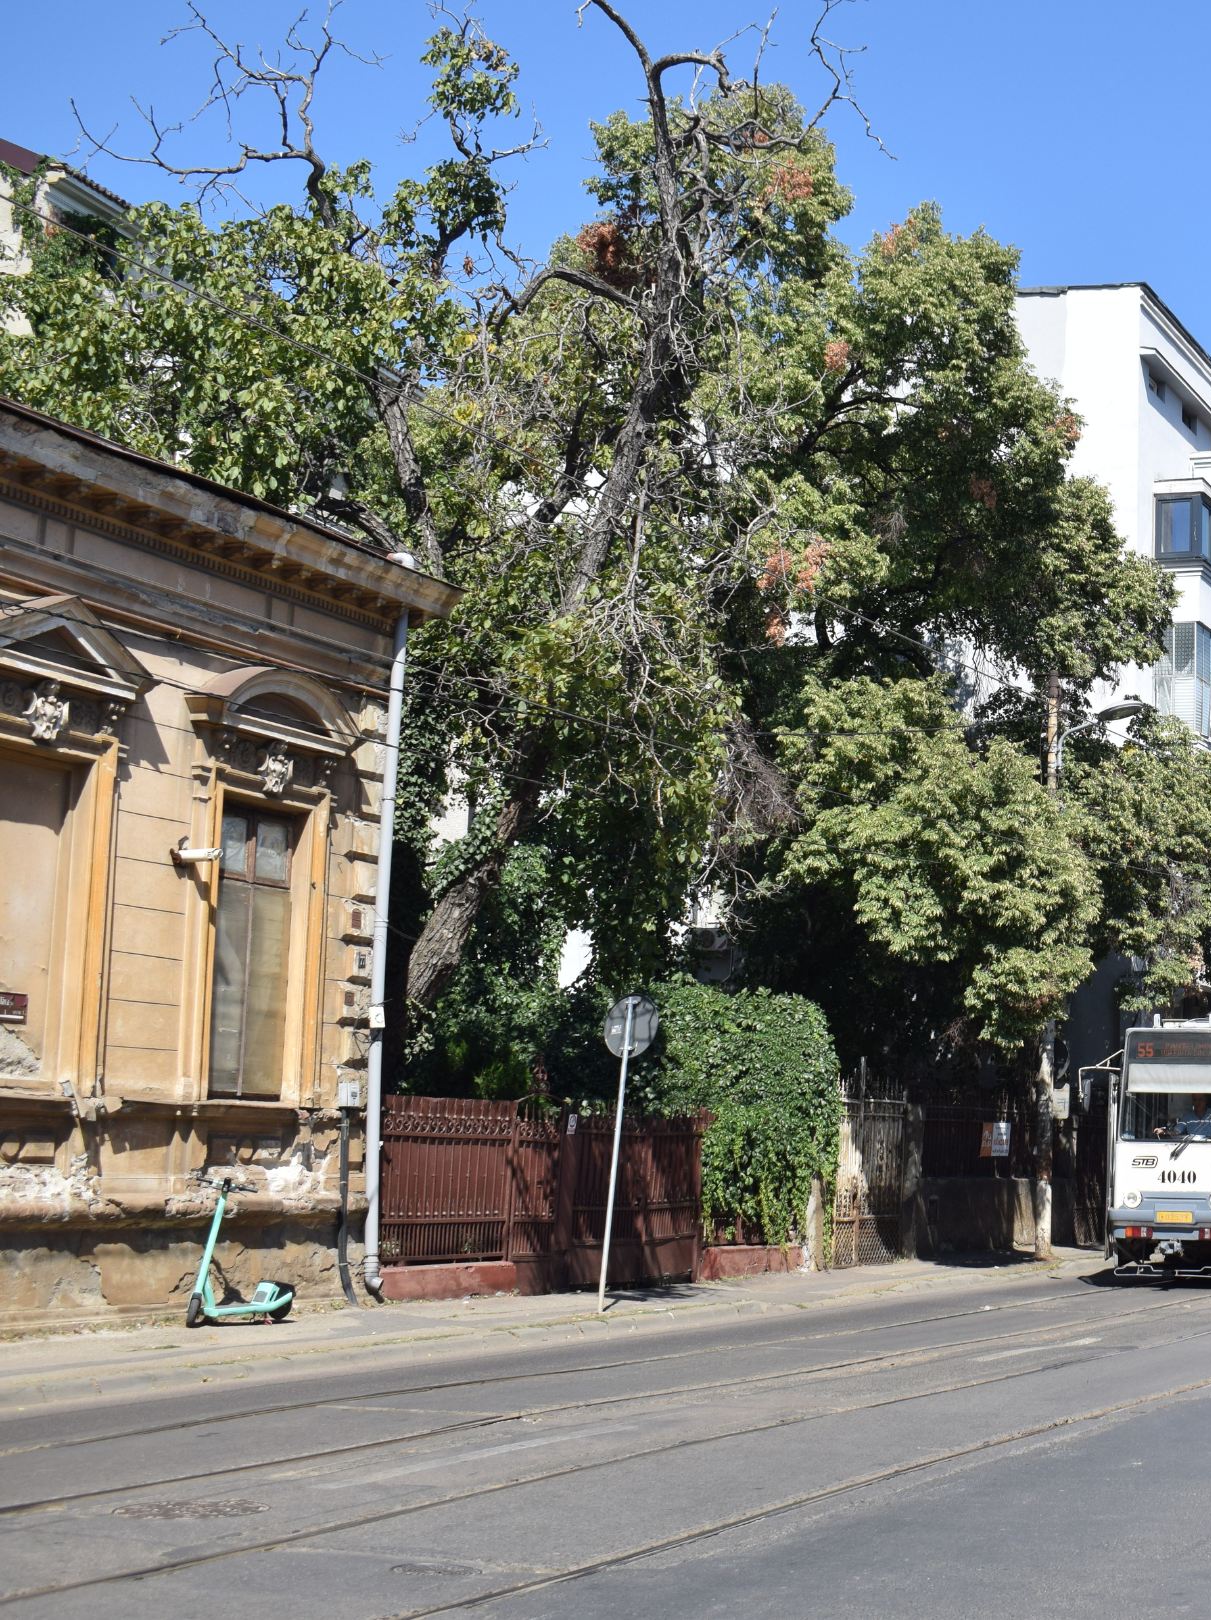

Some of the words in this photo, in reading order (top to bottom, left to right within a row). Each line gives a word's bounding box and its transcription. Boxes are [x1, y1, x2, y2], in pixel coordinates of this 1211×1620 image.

[1137, 1042, 1154, 1058] 55
[1131, 1157, 1157, 1167] STB
[1157, 1170, 1197, 1184] 4040
